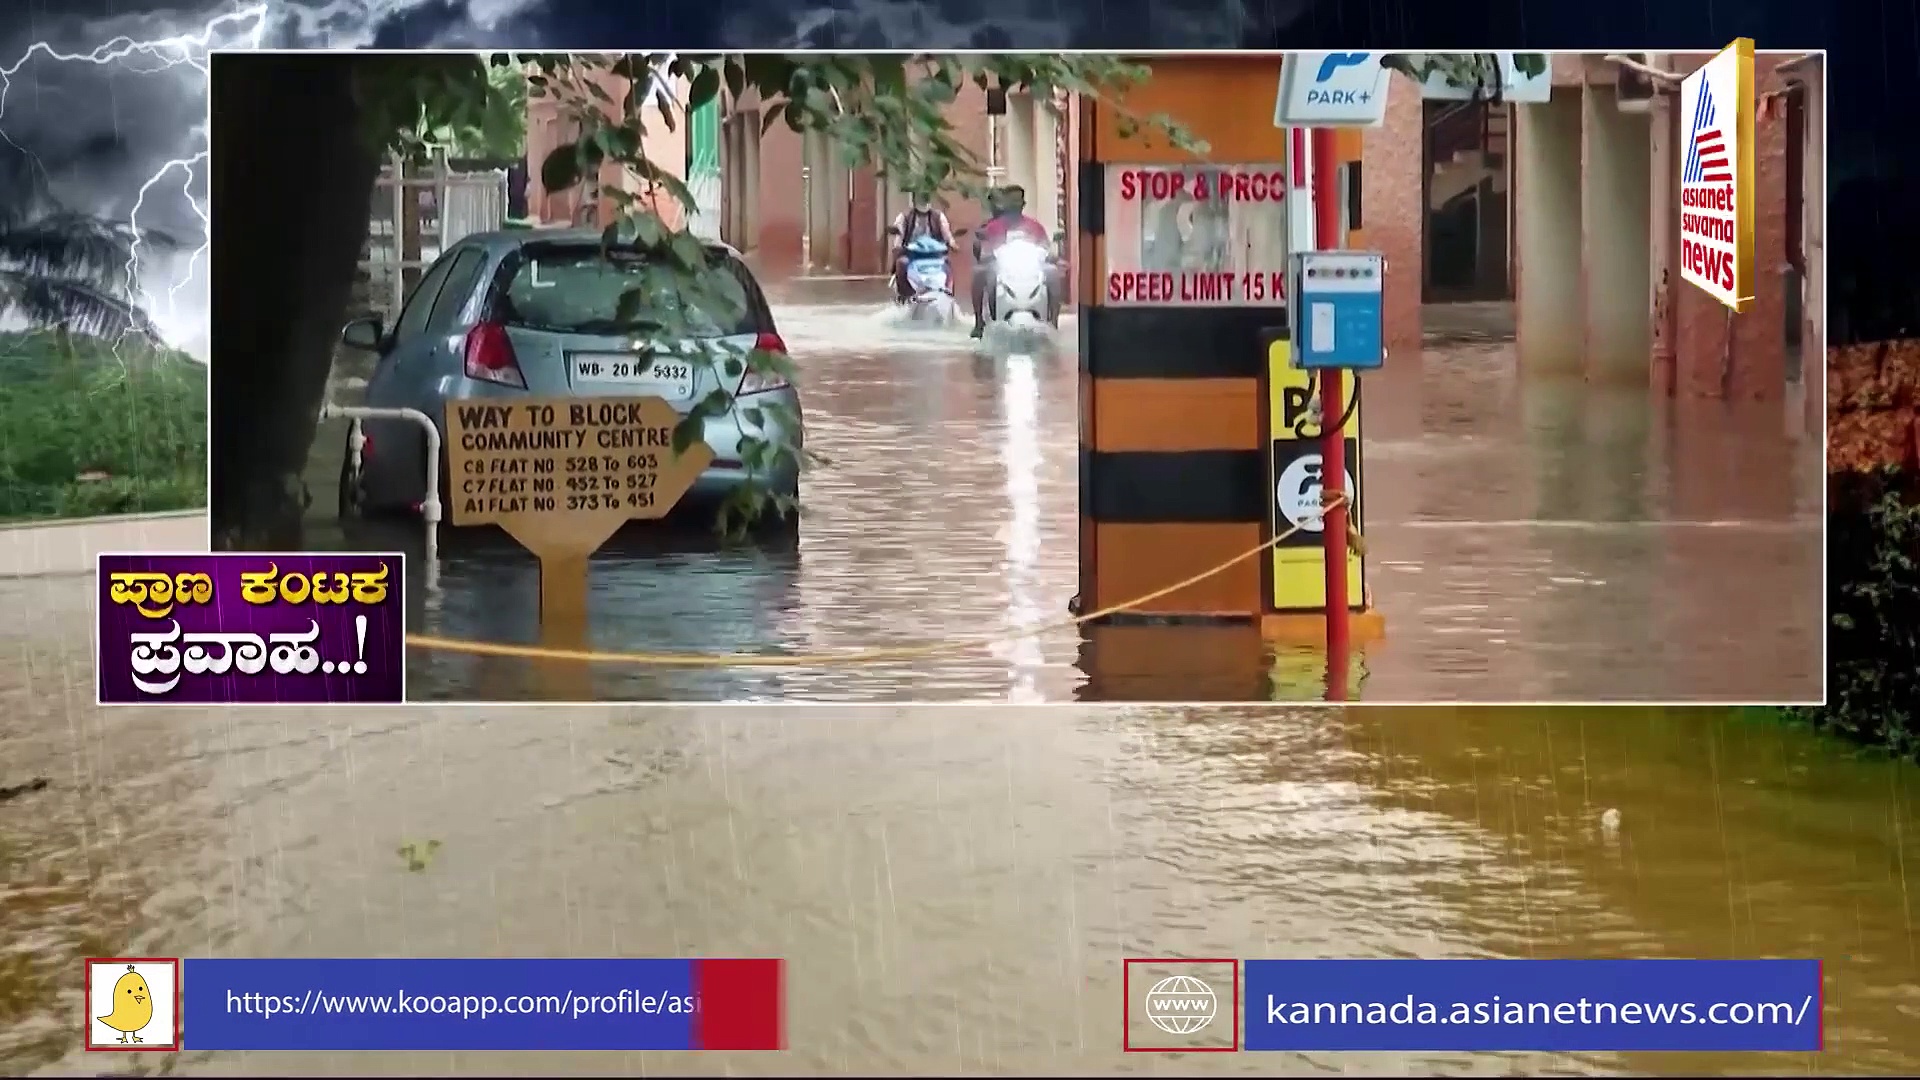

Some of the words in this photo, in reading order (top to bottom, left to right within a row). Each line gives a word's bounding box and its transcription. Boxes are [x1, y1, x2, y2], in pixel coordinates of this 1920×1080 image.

[1307, 90, 1355, 105] PARK
[1121, 171, 1184, 200] STOP
[1193, 172, 1210, 200] &
[1110, 272, 1174, 301] SPEED
[1181, 273, 1235, 301] LIMIT
[1243, 273, 1265, 301] 15
[458, 405, 512, 430] WAY
[525, 405, 555, 427] TO
[570, 403, 642, 426] BLOCK
[461, 429, 586, 451] COMMUNITY
[597, 427, 670, 448] CENTRE
[464, 461, 484, 474] C8
[490, 459, 527, 474] FLAT
[565, 456, 598, 472] 528
[627, 454, 658, 470] 603
[463, 480, 484, 494] C7
[489, 480, 525, 494] FLAT
[464, 499, 484, 513] A1
[489, 498, 526, 513] FLAT
